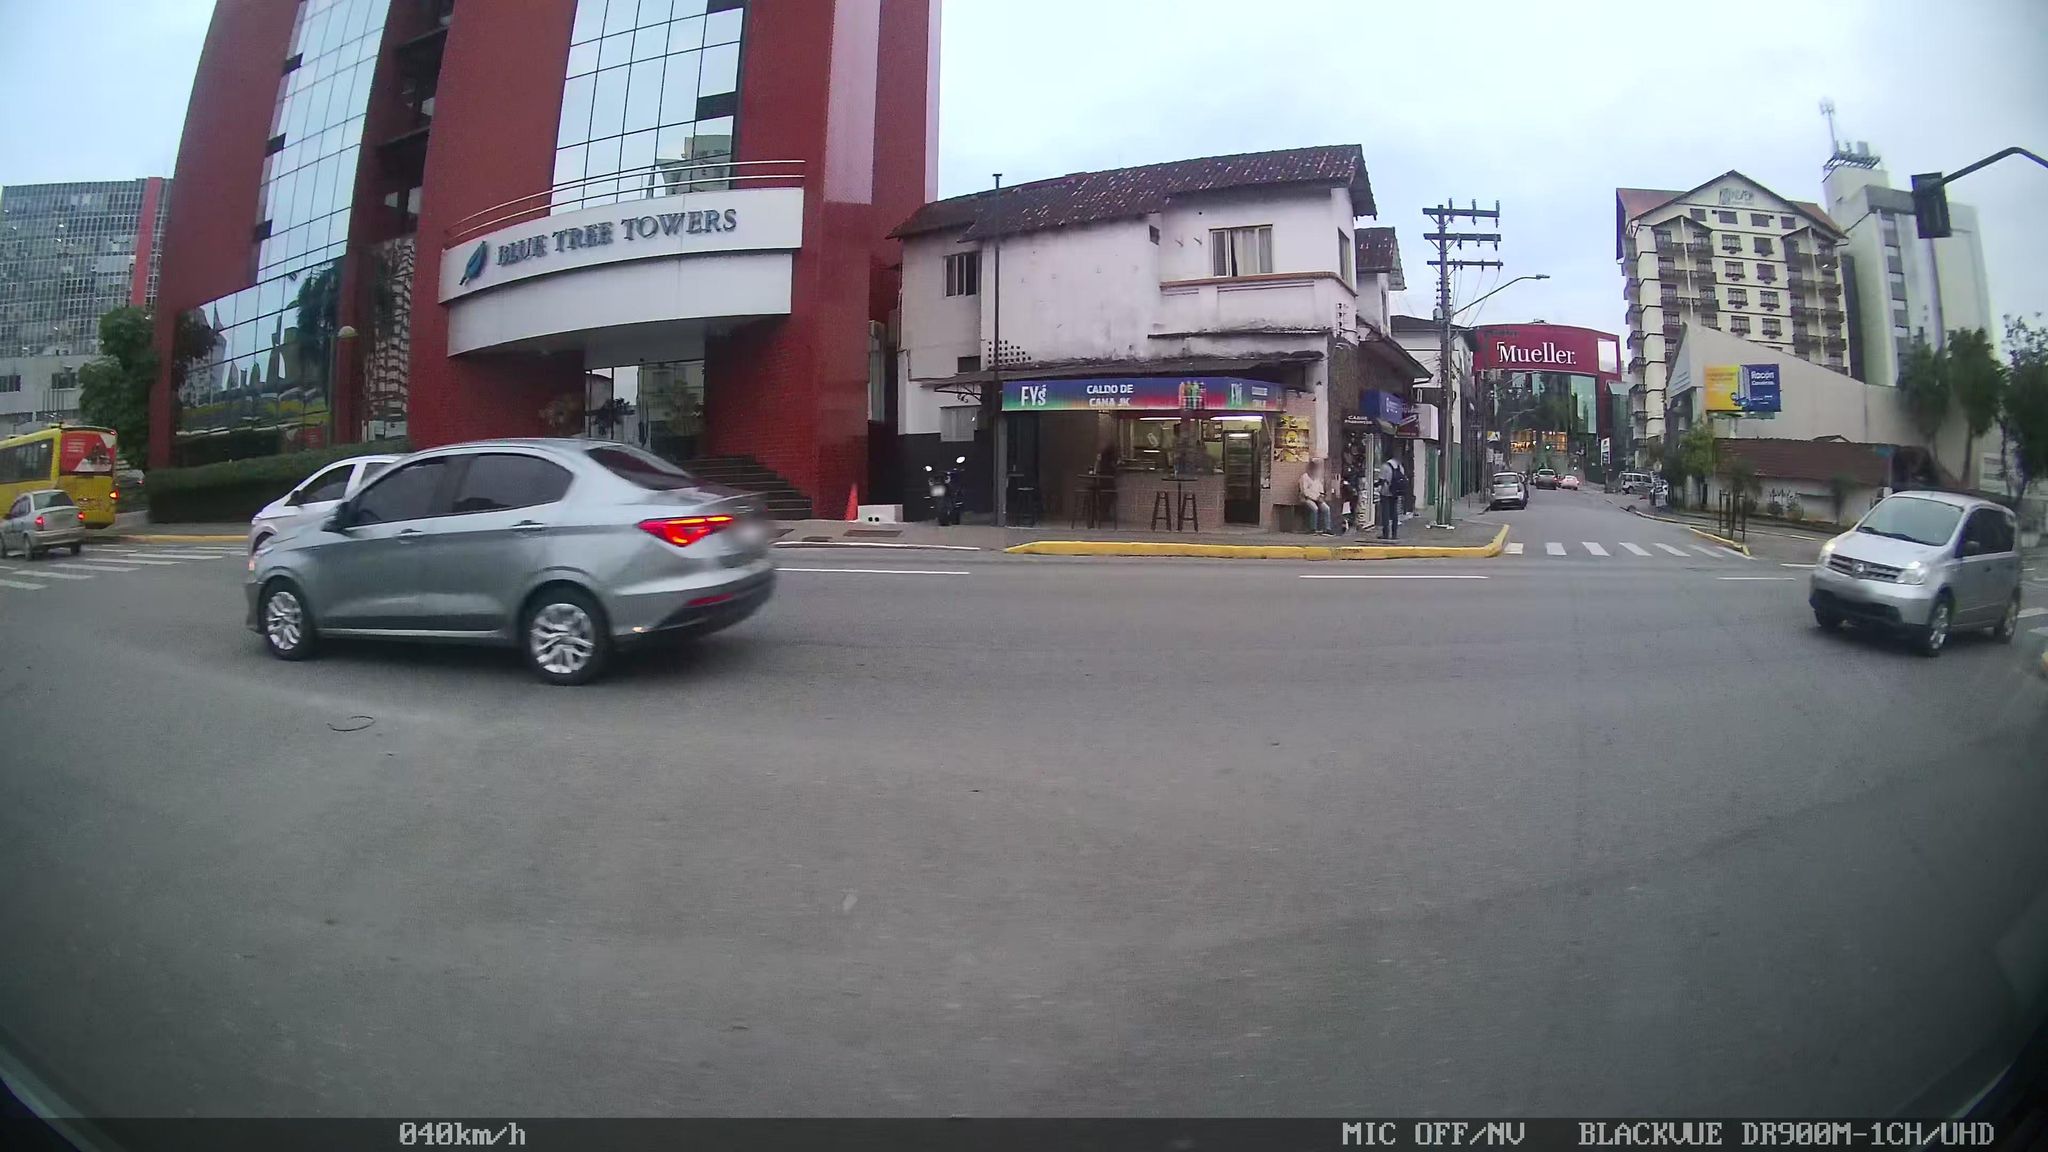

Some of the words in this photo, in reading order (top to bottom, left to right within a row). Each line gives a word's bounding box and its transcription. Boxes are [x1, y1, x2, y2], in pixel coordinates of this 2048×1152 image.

[496, 234, 548, 267] BLUE
[552, 221, 615, 253] TREE
[621, 208, 738, 241] TOWERS
[1086, 385, 1118, 394] CALDO
[1119, 384, 1134, 393] DE
[1088, 398, 1115, 407] CANA
